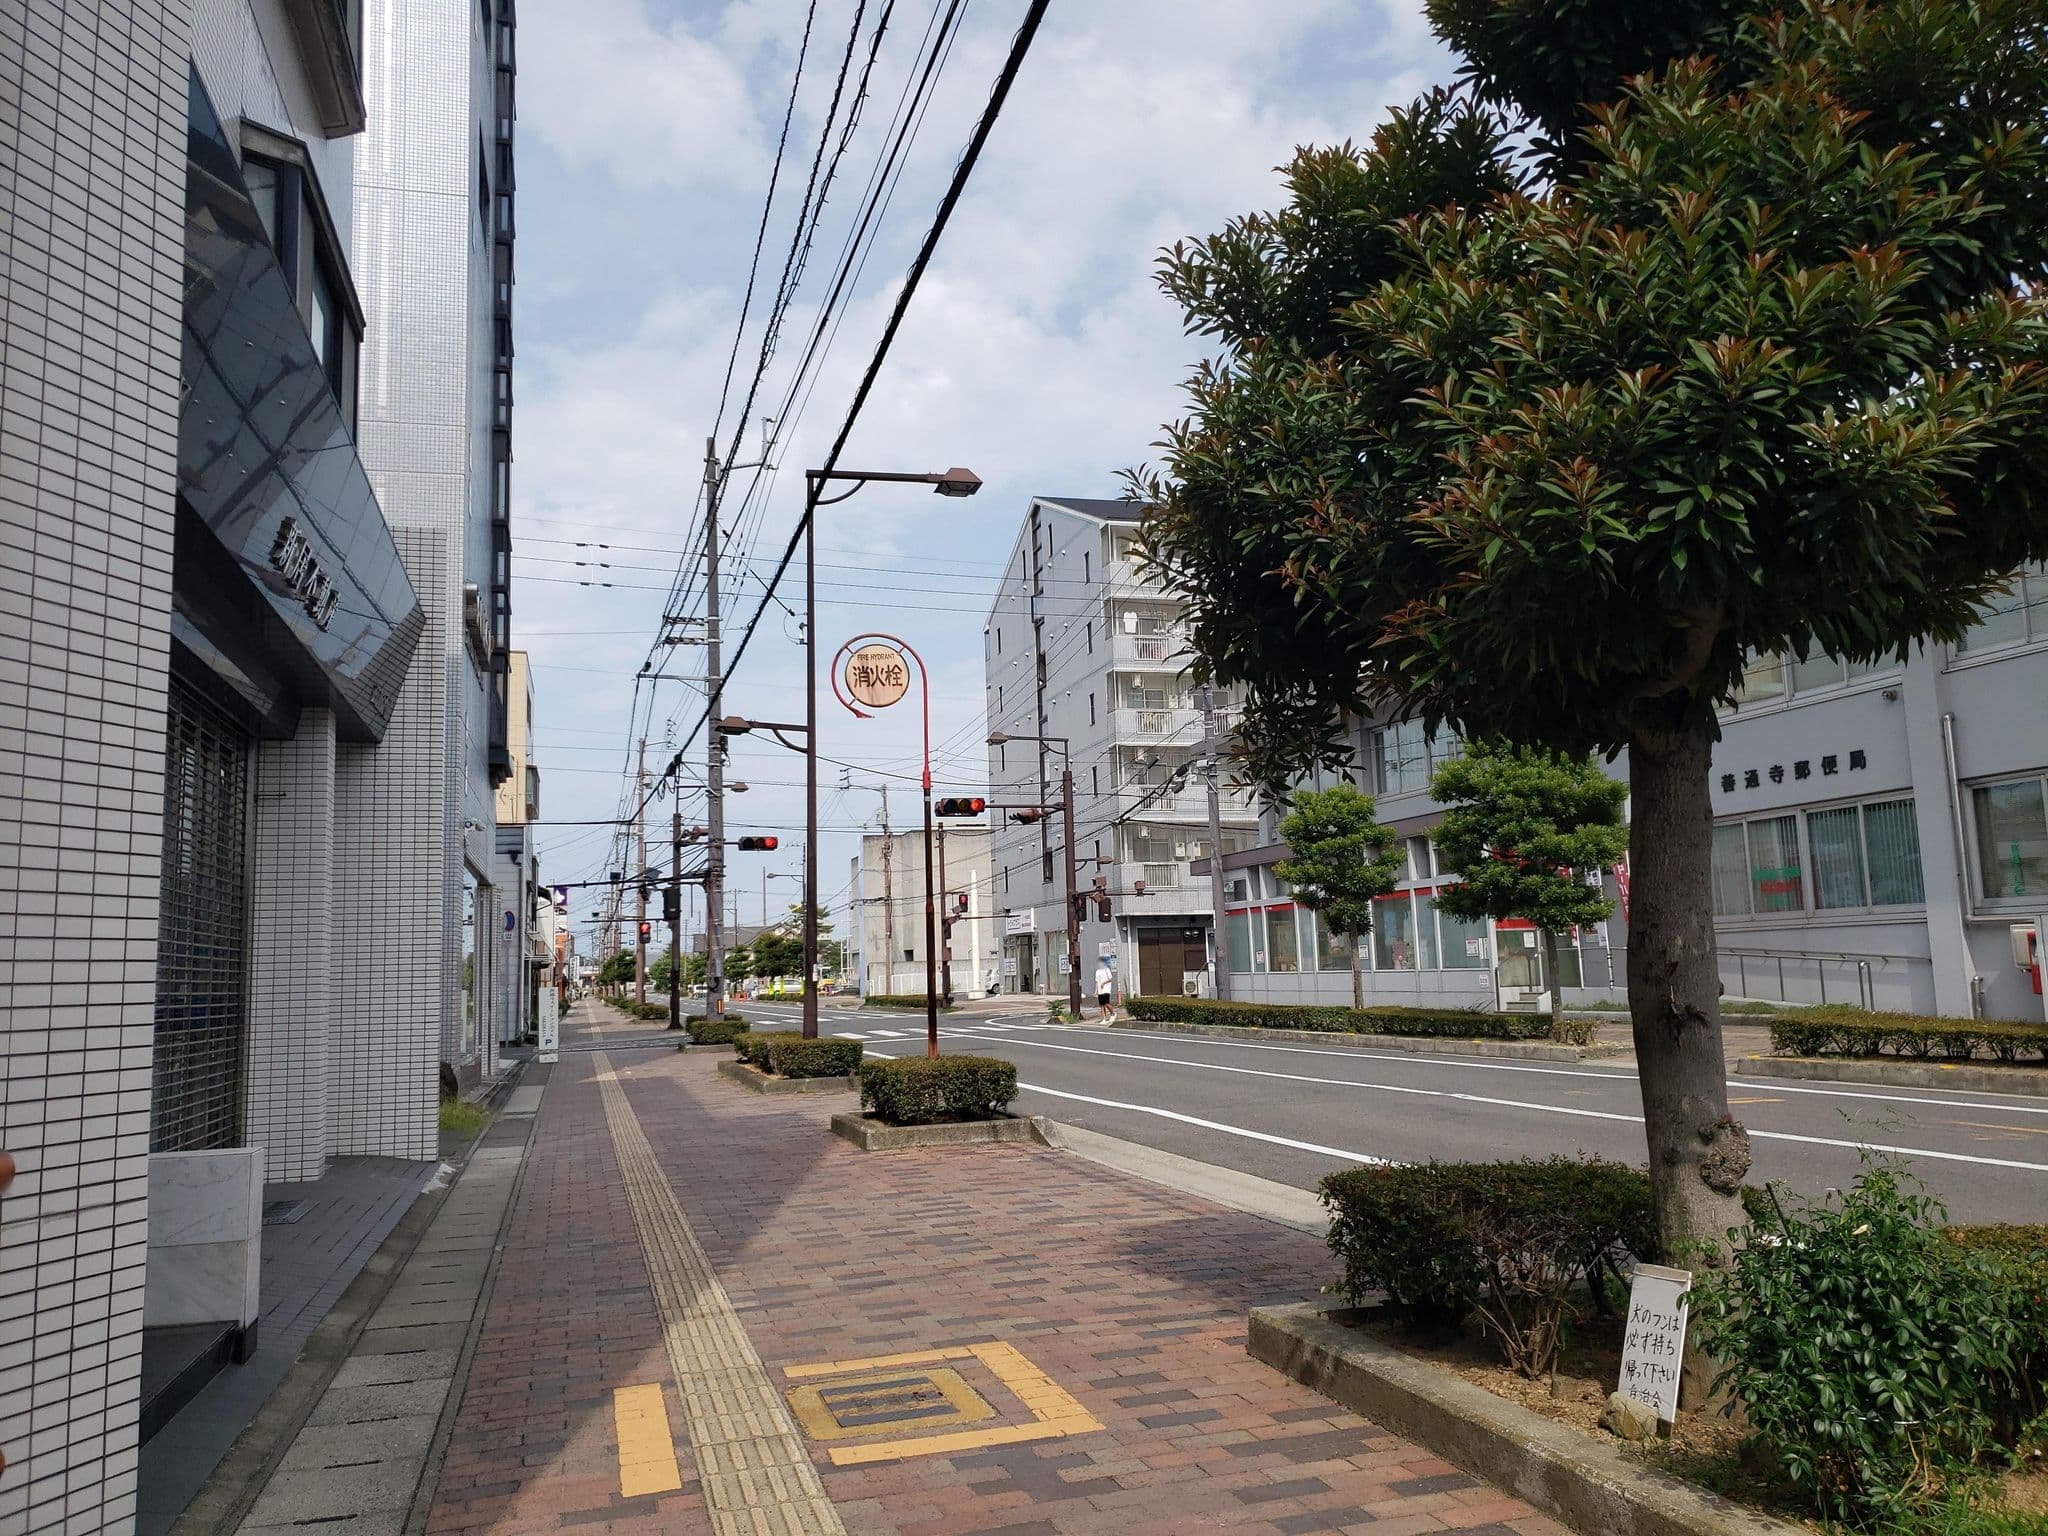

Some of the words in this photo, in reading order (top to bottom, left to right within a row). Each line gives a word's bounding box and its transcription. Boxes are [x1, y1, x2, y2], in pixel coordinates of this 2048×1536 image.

[857, 653, 869, 661] FIRE
[852, 664, 903, 688] 消火栓
[1721, 749, 1866, 793] 善通寺郵便局
[1630, 1303, 1679, 1331] 犬のフンは
[1625, 1329, 1675, 1356] 必ず持ち
[1625, 1360, 1675, 1384] 帰って下さい
